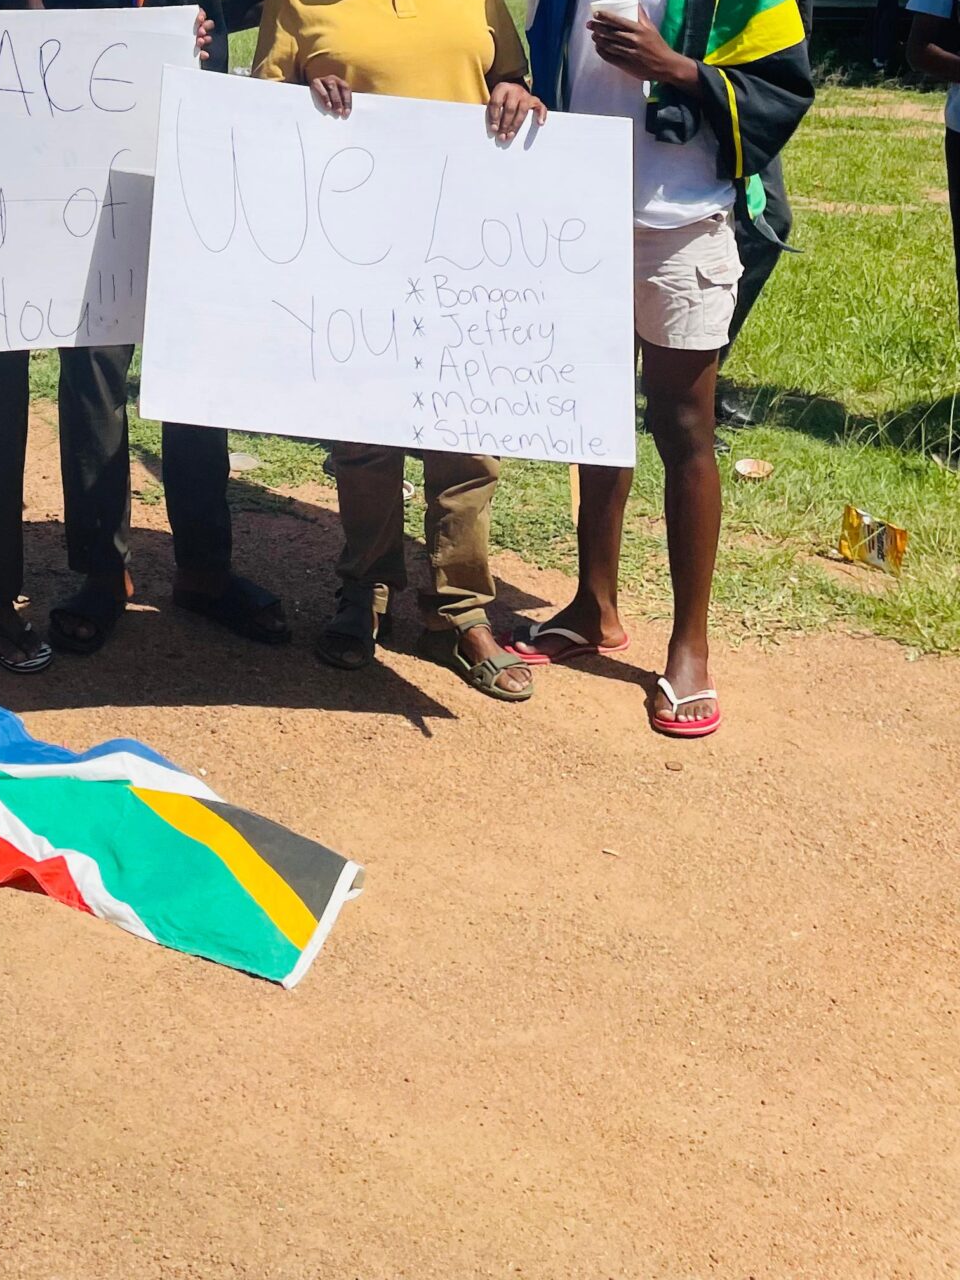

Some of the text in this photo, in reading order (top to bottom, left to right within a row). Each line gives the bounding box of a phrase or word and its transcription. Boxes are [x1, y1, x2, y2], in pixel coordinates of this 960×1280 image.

[62, 148, 131, 239] of
[175, 97, 601, 274] We Love
[433, 274, 546, 320] Bongani
[439, 346, 576, 397] Aphane
[431, 390, 578, 422] Mandisa
[433, 419, 607, 456] Sthembile
